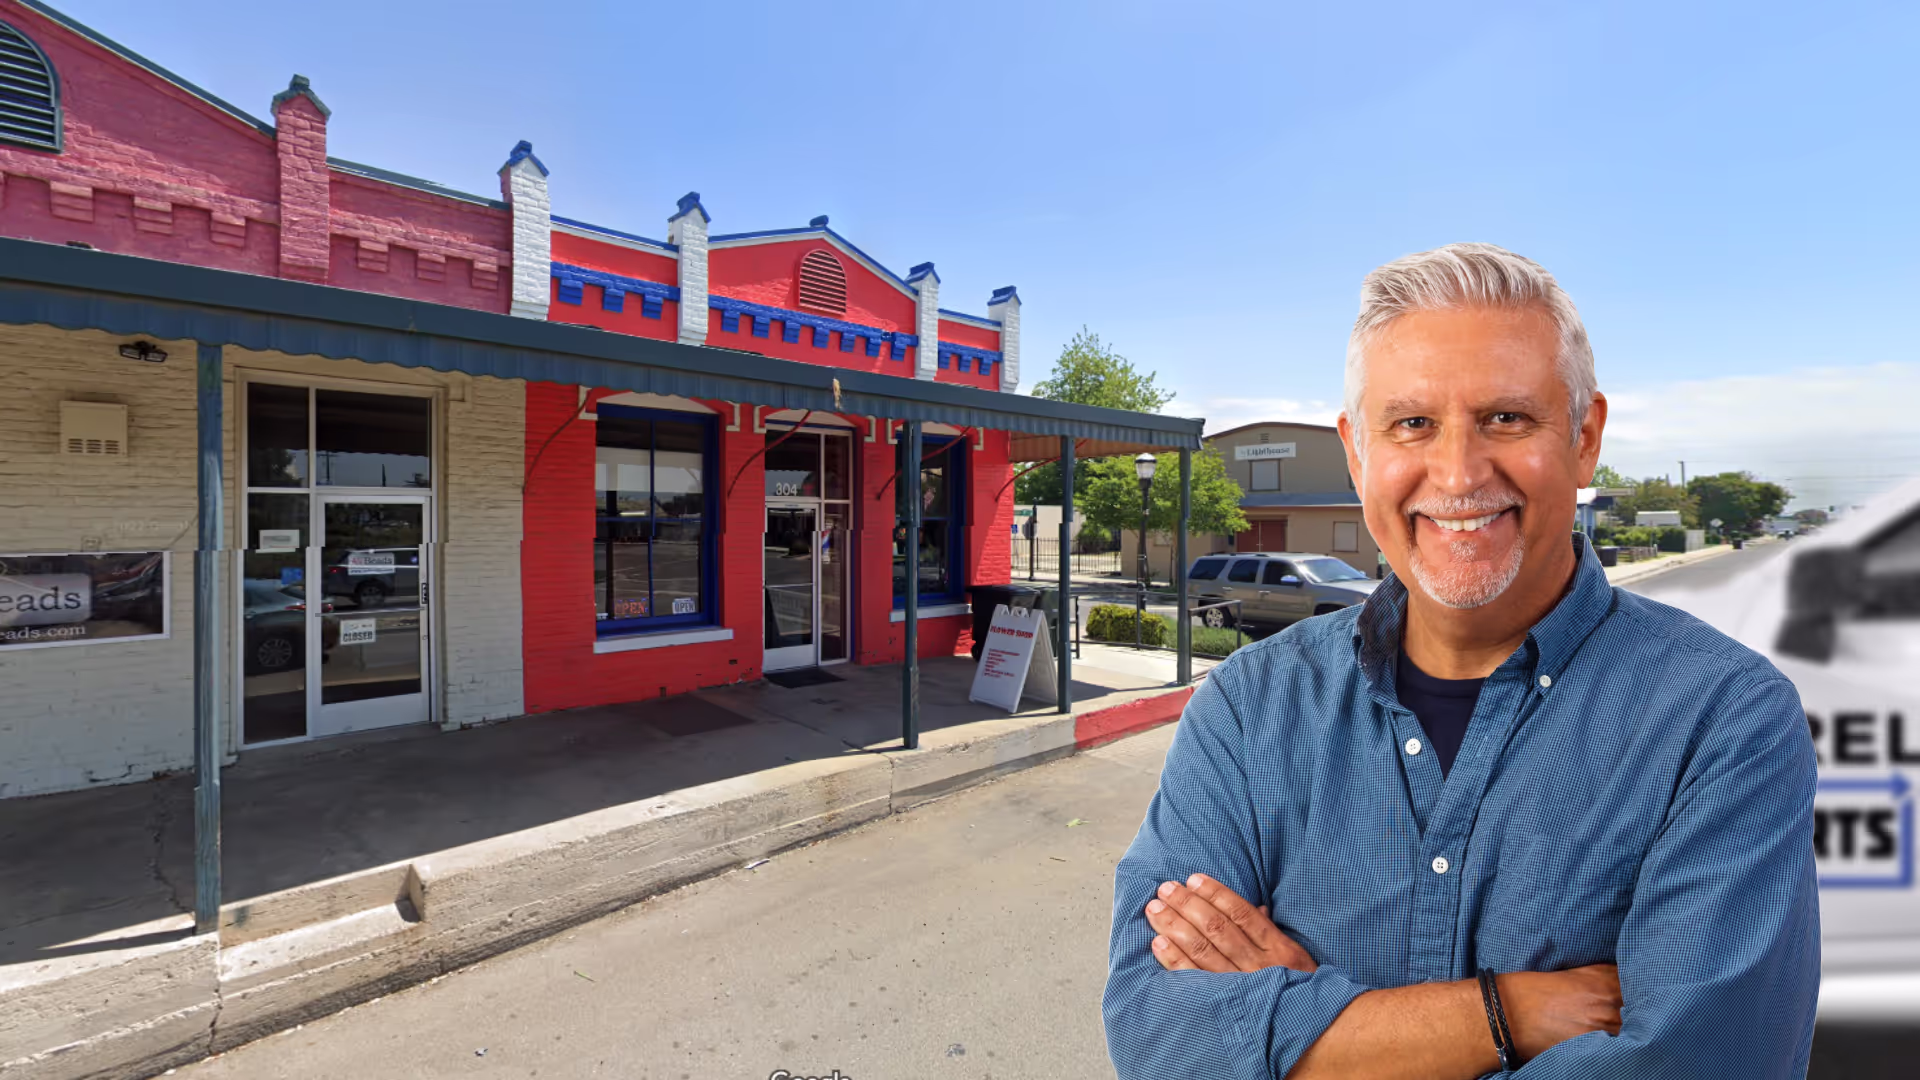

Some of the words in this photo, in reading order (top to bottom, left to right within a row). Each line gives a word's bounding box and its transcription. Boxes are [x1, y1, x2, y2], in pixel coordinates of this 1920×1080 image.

[1247, 447, 1290, 457] Lighthouse
[776, 482, 797, 496] 304
[0, 585, 82, 613] eads
[614, 602, 646, 614] OPEN
[674, 601, 695, 613] OPEN
[343, 631, 373, 642] CLOSED
